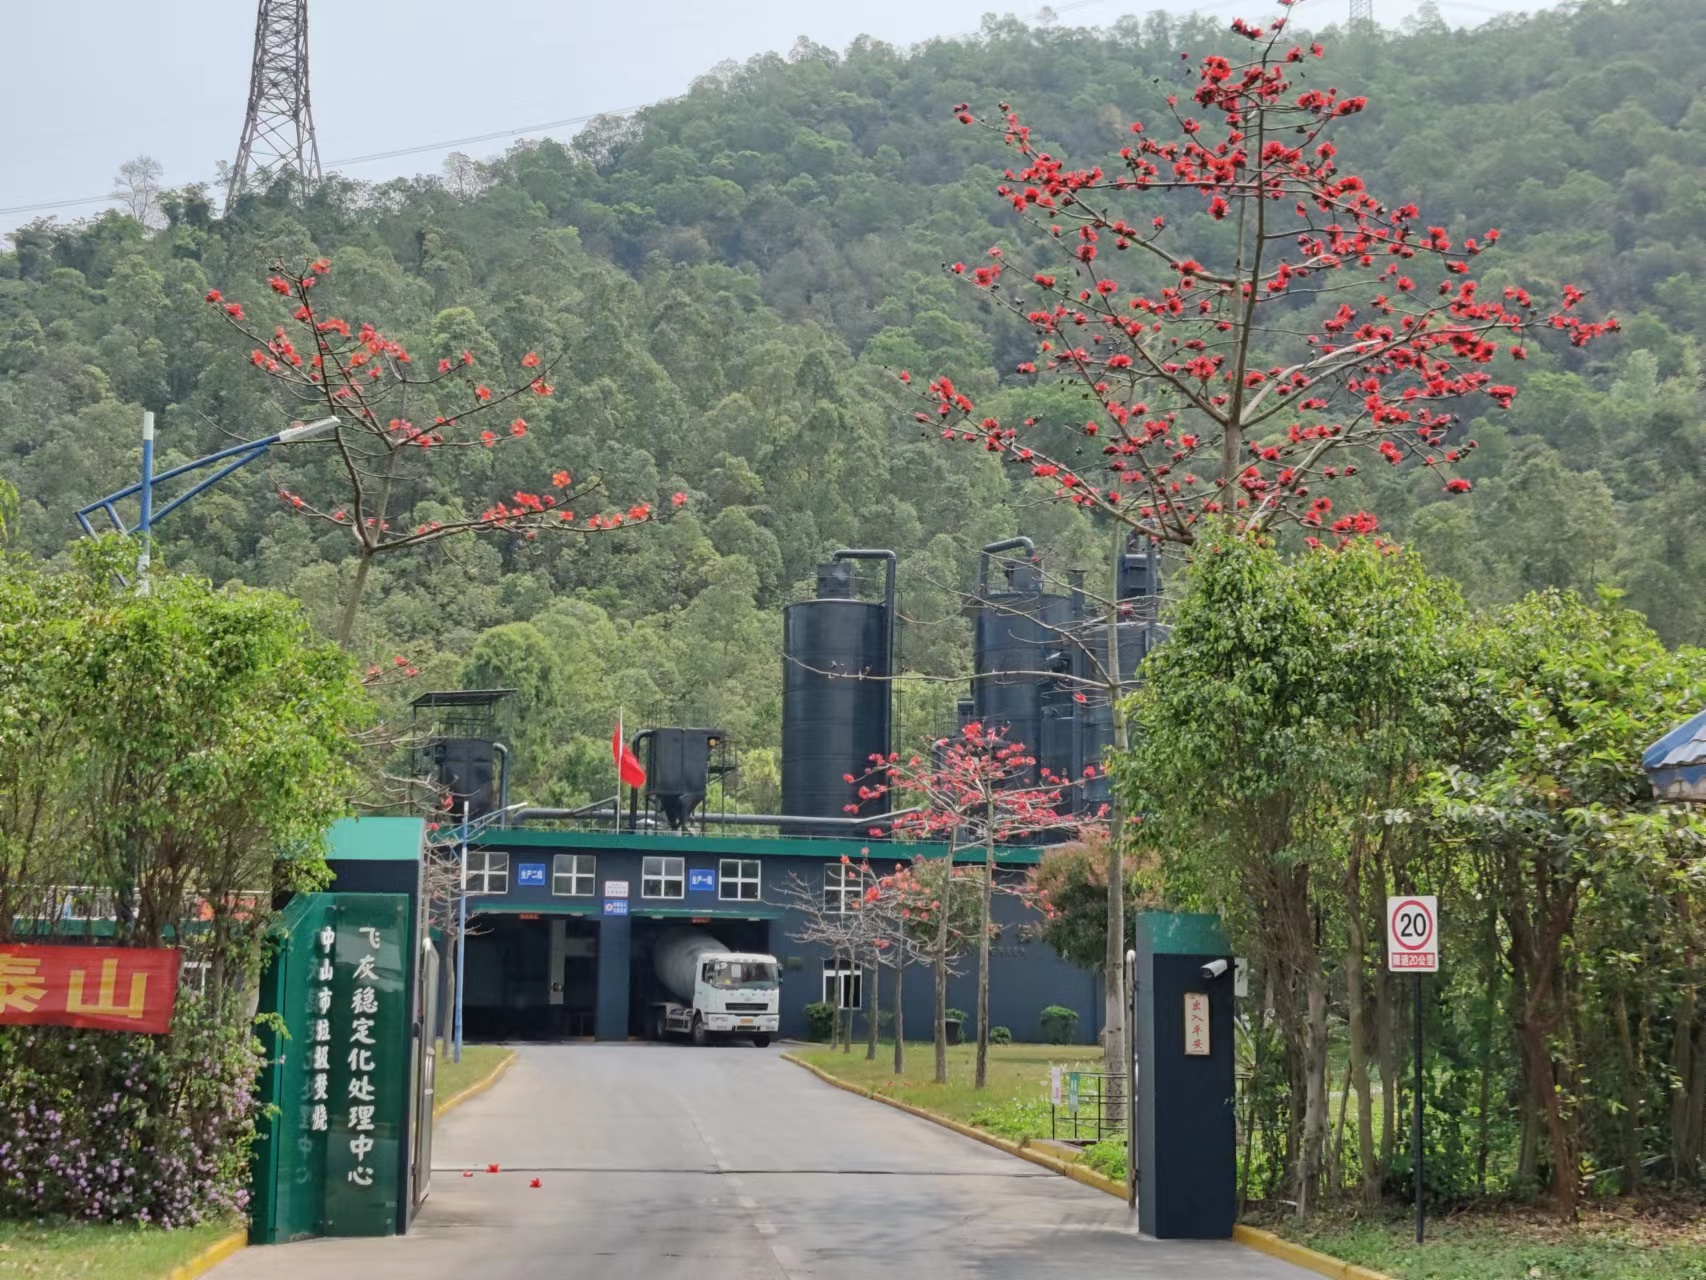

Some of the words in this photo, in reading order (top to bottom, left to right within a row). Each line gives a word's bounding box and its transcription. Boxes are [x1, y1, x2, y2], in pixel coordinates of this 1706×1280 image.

[1400, 913, 1427, 937] 20
[312, 926, 335, 1131] 中山市垃圾焚烧
[348, 927, 380, 1186] 飞灰稳定化处理中心
[1192, 1000, 1205, 1049] 出入平安
